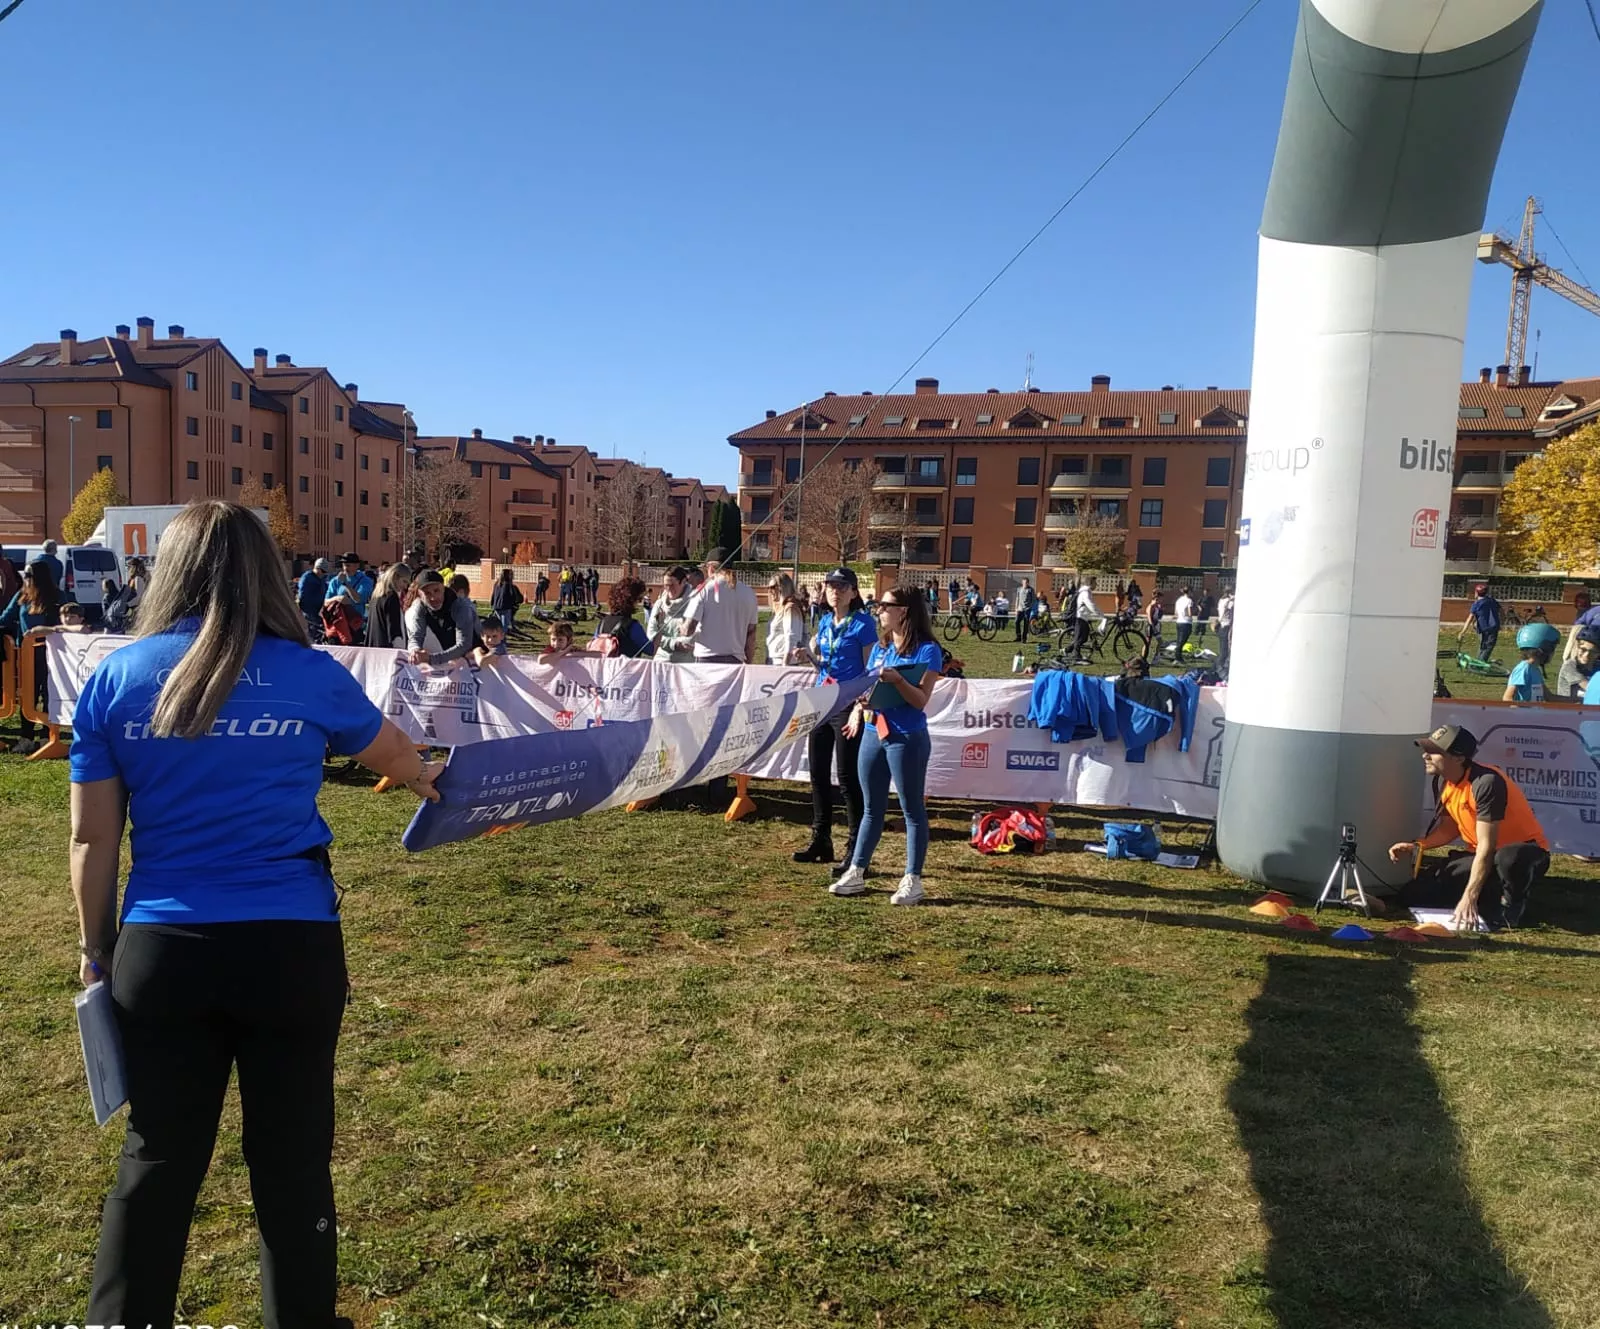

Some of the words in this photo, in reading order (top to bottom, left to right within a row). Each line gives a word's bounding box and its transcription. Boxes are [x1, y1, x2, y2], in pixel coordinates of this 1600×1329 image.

[1010, 754, 1056, 767] SWAG
[481, 759, 588, 786] federación
[1506, 767, 1598, 788] RECAMBIOS
